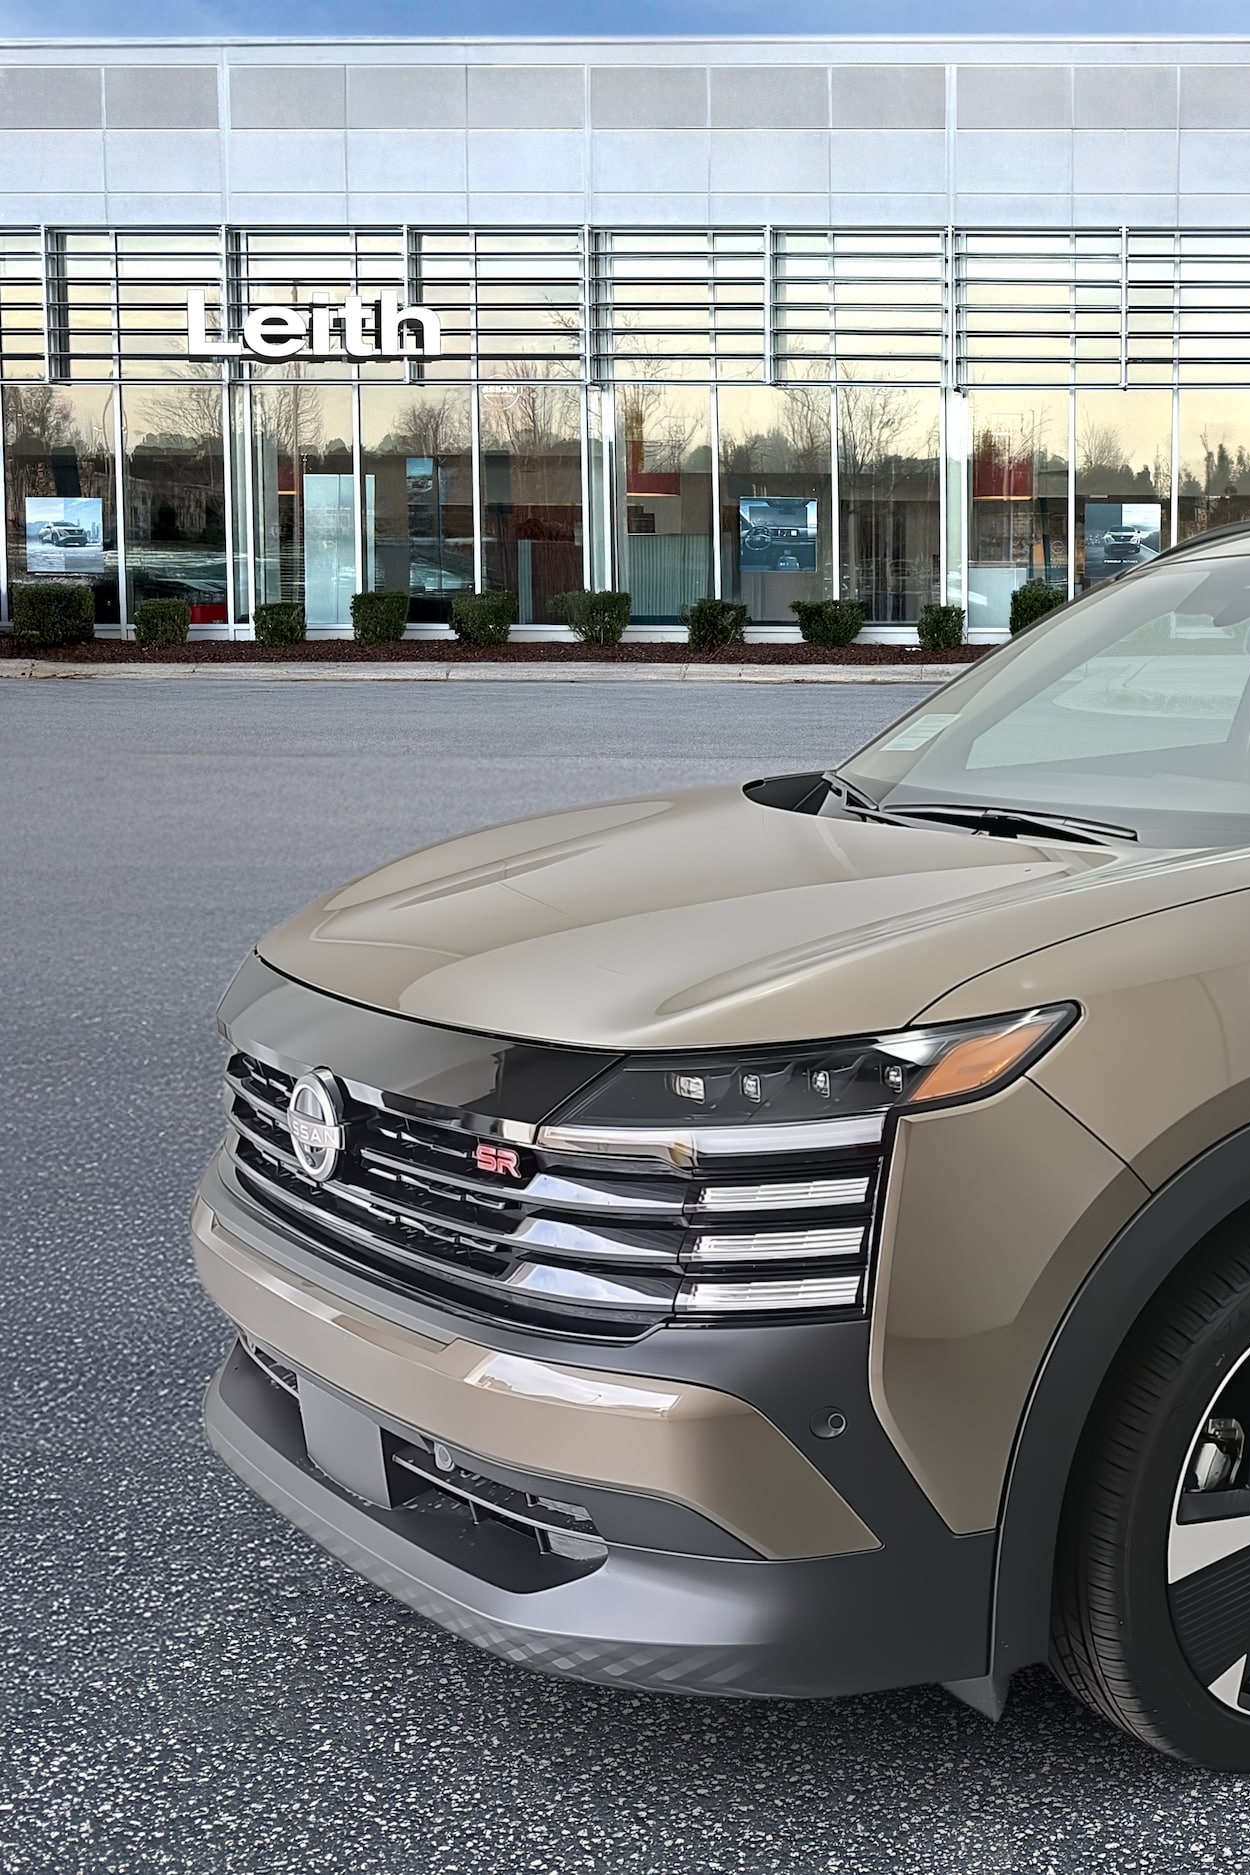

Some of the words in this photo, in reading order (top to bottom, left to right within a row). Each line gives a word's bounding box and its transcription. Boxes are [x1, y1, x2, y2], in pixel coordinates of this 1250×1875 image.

[187, 289, 442, 357] Leith
[292, 1120, 337, 1145] SSAN
[476, 1144, 521, 1178] SR
